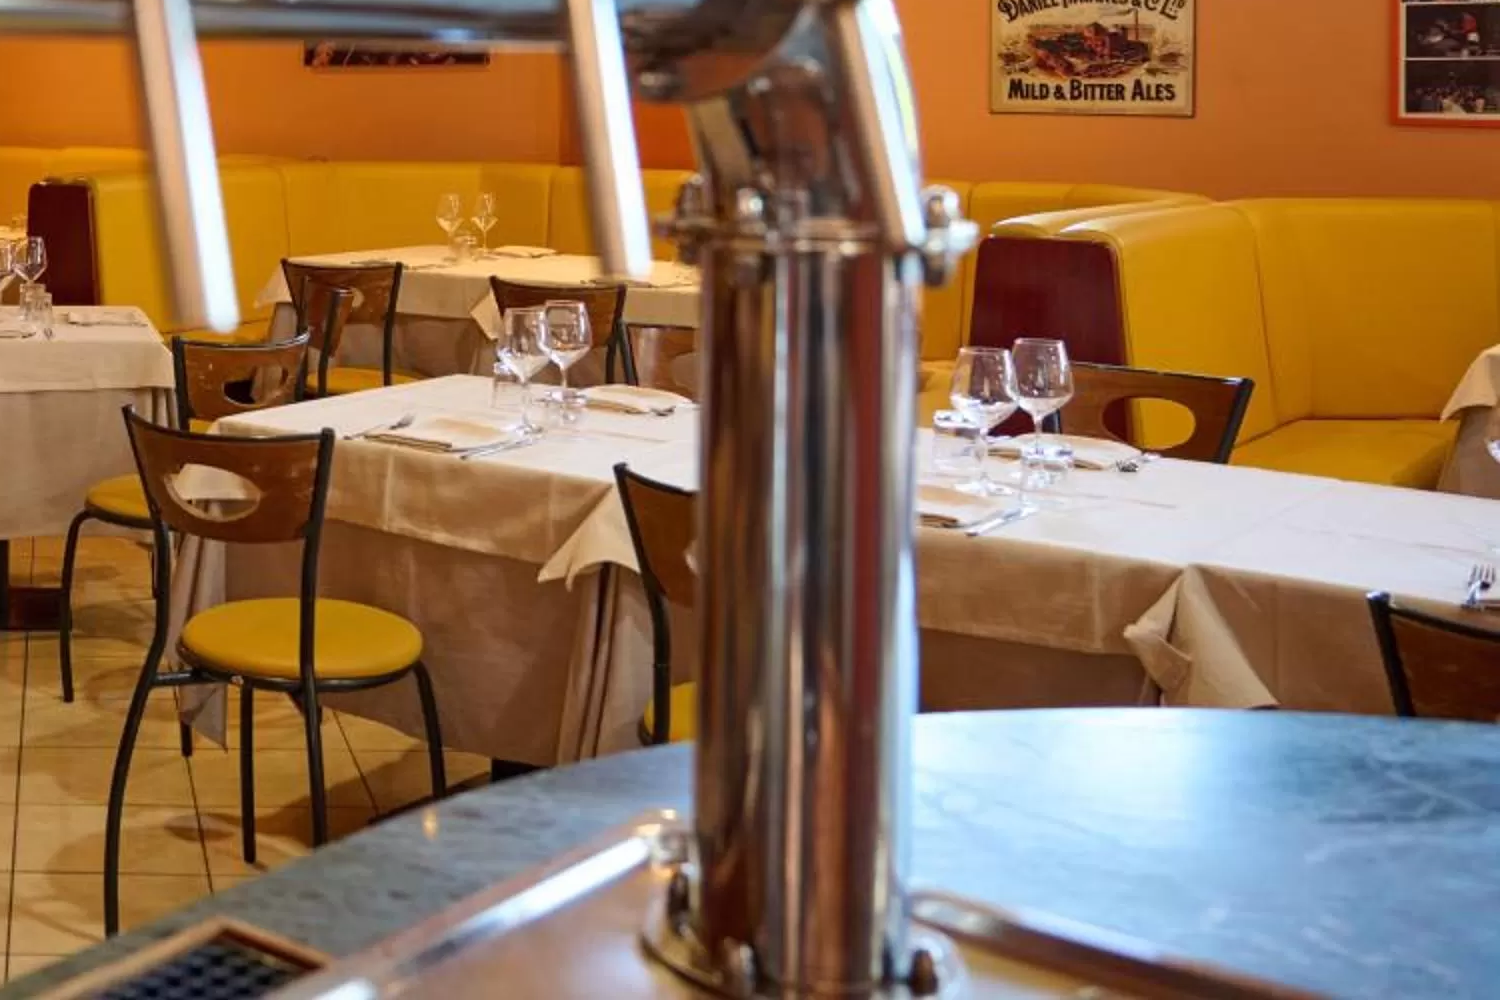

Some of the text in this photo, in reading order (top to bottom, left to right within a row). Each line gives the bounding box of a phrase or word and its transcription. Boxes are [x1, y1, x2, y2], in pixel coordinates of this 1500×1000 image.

[1008, 78, 1176, 101] MILD & BITTER ALES
